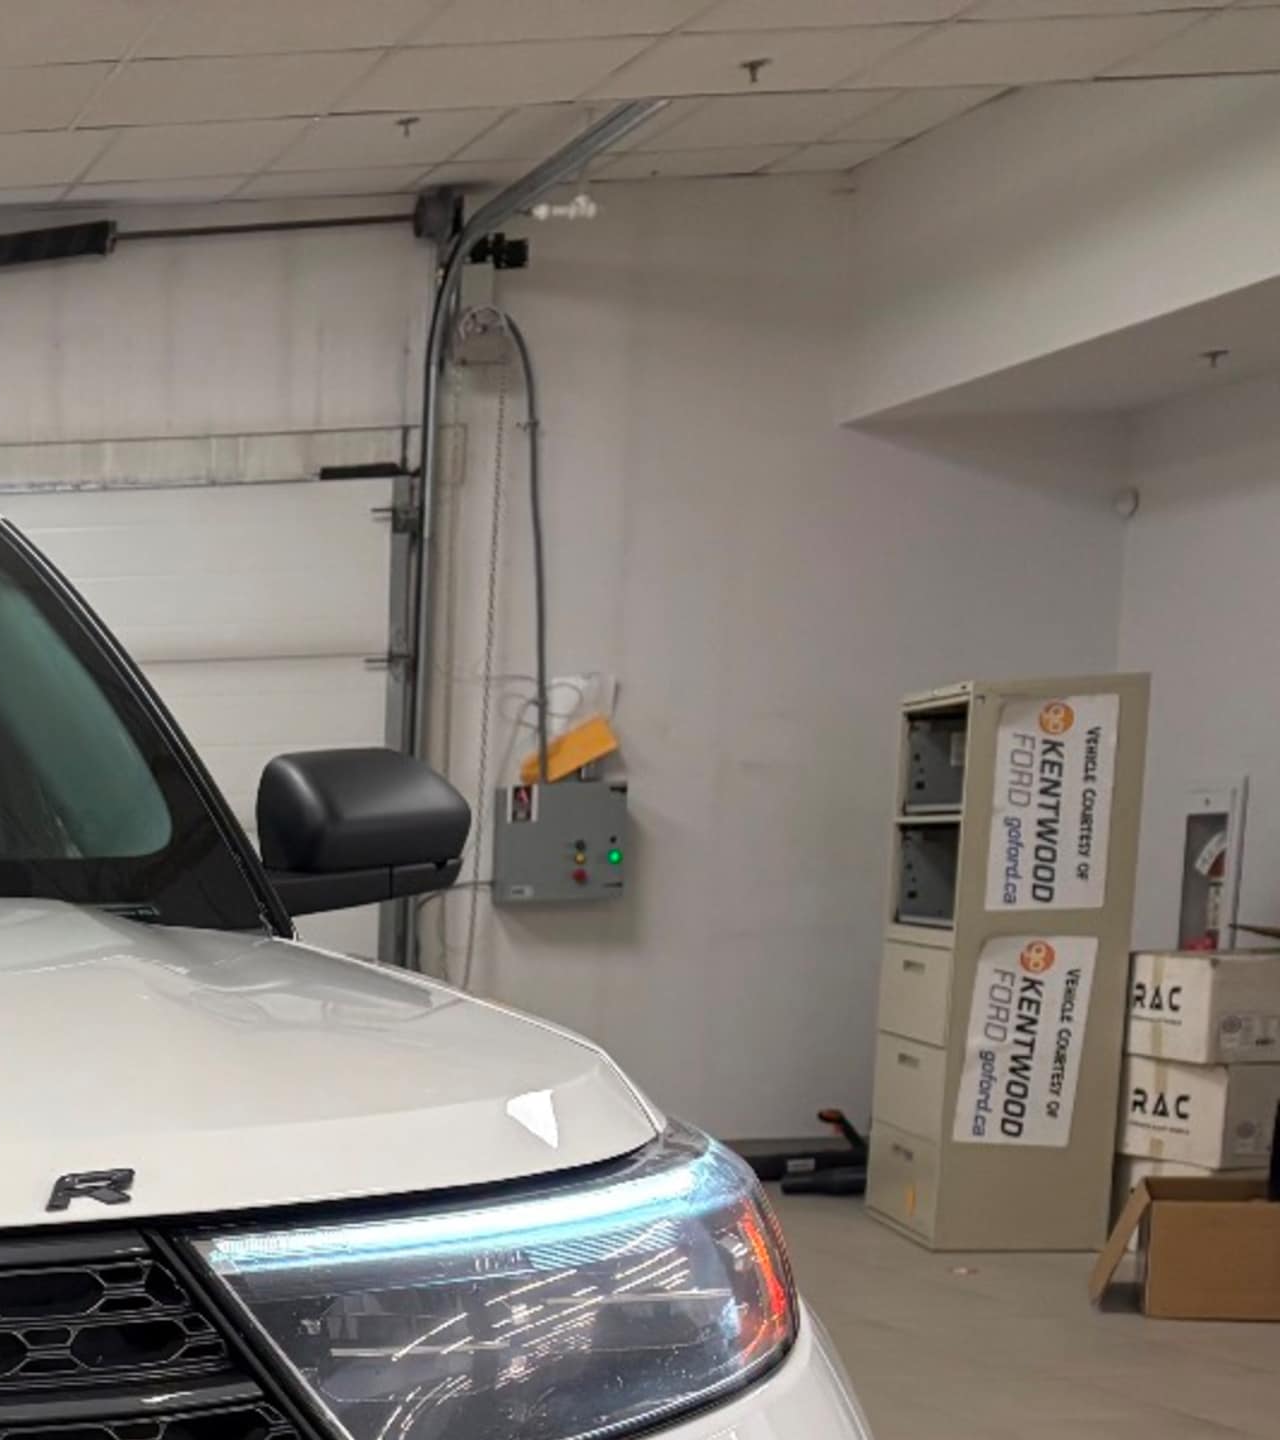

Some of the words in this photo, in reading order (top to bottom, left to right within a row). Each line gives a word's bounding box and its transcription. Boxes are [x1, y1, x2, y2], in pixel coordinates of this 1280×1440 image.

[1008, 732, 1036, 809] FORD
[1083, 726, 1101, 783] VEHICLE
[1032, 739, 1064, 903] KENTWOOD
[1077, 787, 1096, 857] COURTESY
[1003, 816, 1024, 904] goford.ca
[1077, 863, 1090, 880] OF
[984, 968, 1015, 1044] FORD
[973, 1050, 997, 1136] goford.ca
[1001, 976, 1044, 1138] KENTWOOD
